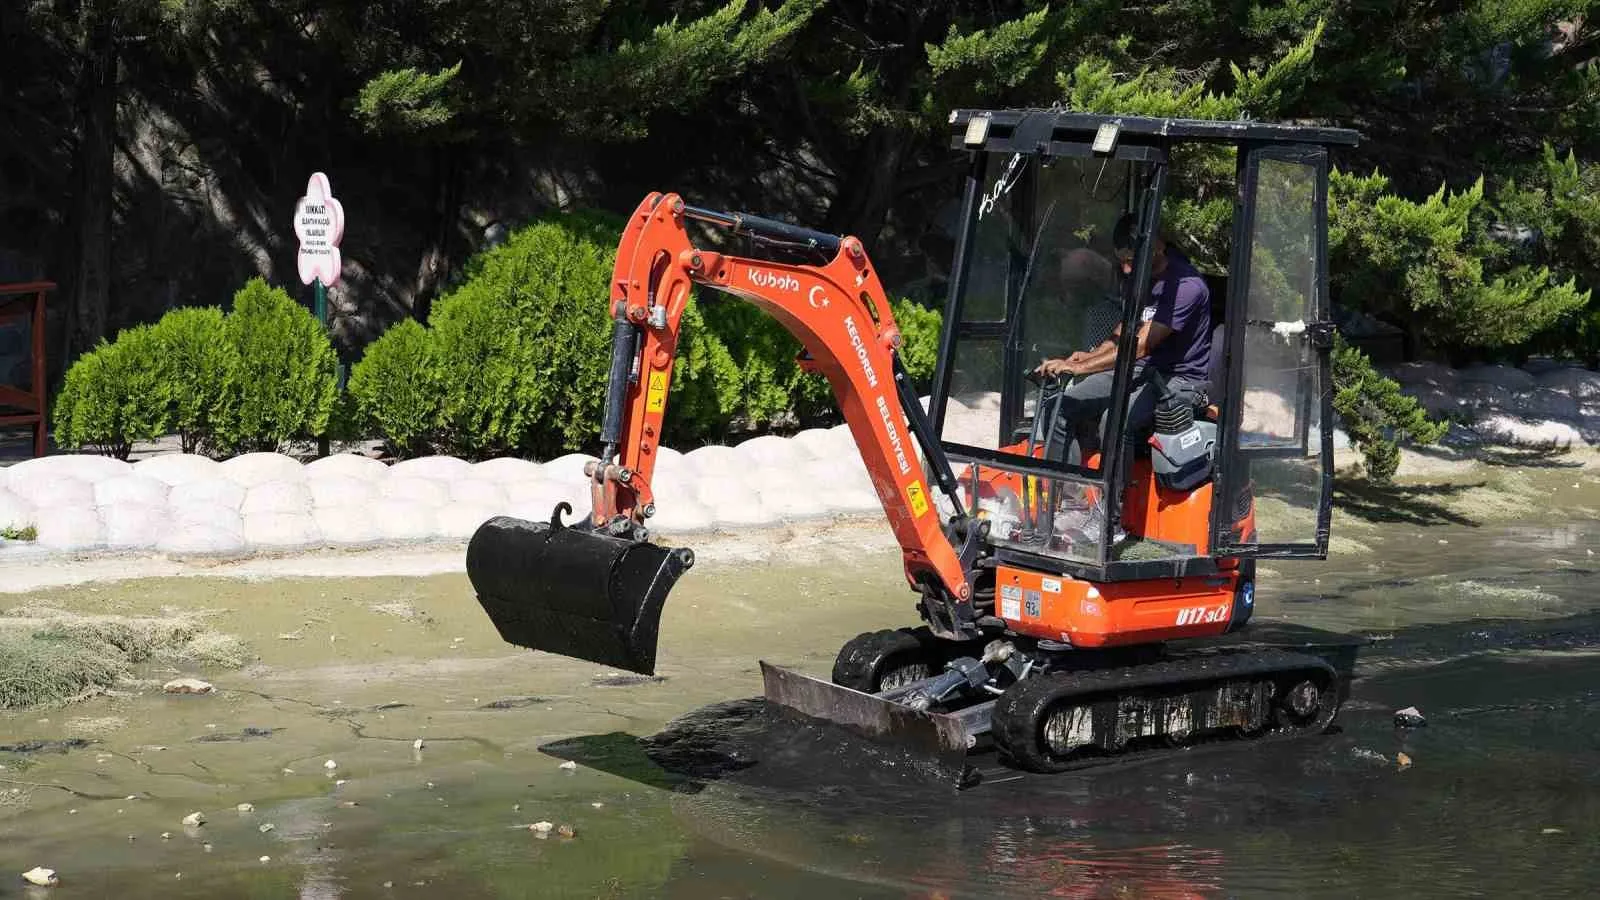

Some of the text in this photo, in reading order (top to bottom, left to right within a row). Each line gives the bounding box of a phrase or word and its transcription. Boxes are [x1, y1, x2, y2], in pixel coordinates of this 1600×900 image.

[748, 268, 800, 292] Kubota
[844, 316, 911, 475] KEÇİÖREN BELEDİYESİ
